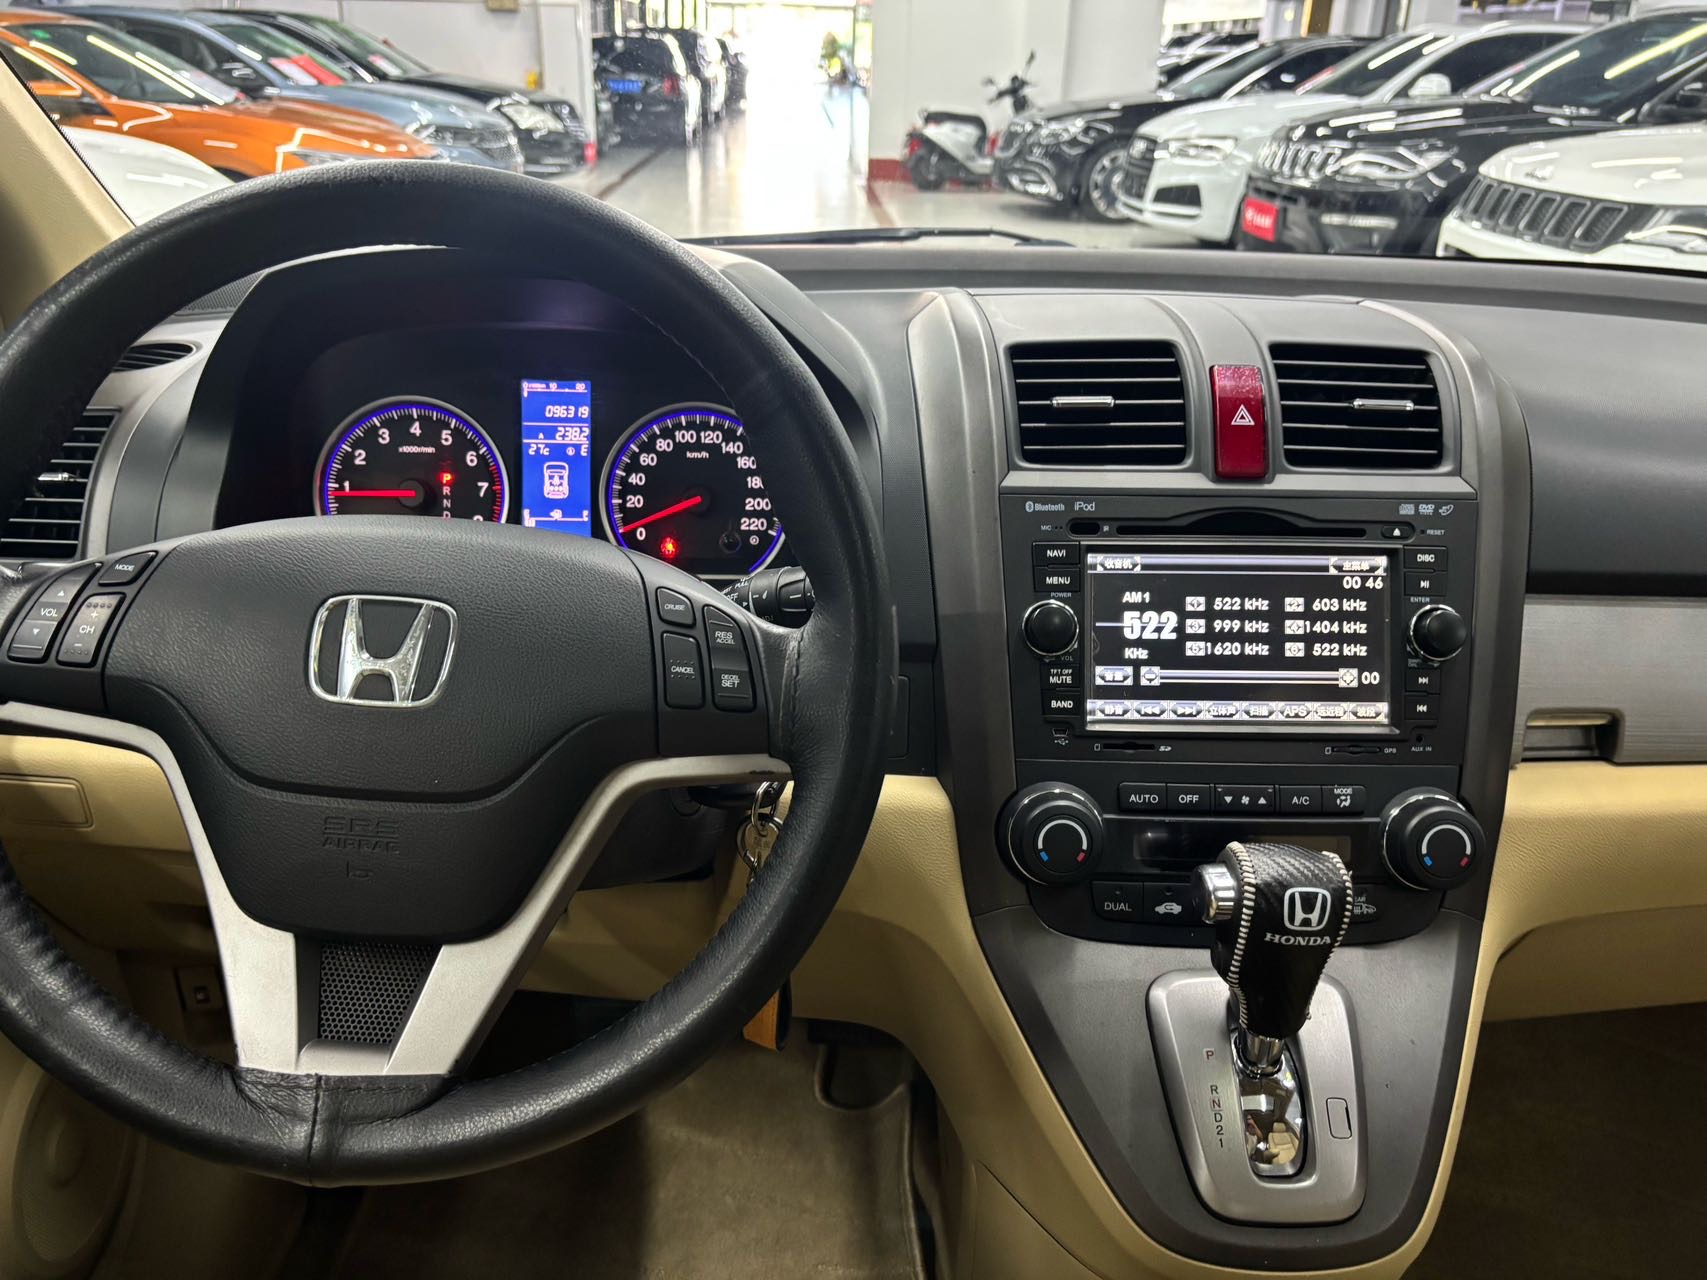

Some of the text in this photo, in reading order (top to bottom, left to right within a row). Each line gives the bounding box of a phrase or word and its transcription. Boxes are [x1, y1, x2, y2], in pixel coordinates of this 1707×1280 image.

[545, 405, 589, 418] 096319
[410, 421, 422, 437] 4
[378, 428, 391, 444] 3
[441, 430, 452, 445] 5
[675, 431, 697, 443] 100
[700, 431, 722, 443] 120
[656, 439, 673, 451] 80
[721, 442, 743, 454] 140
[354, 450, 366, 465] 2
[466, 451, 478, 467] 6
[639, 454, 657, 466] 60
[686, 451, 709, 459] km/h
[737, 456, 757, 469] 160
[442, 473, 452, 484] P
[628, 474, 645, 486] 40
[343, 480, 350, 492] 1
[443, 487, 451, 496] R
[477, 482, 489, 497] 7
[443, 499, 451, 508] N
[626, 495, 643, 507] 20
[745, 498, 771, 511] 200
[1034, 503, 1065, 511] Bluetooth
[1074, 502, 1096, 511] iPod
[740, 518, 767, 531] 220
[636, 528, 646, 540] 0
[1046, 550, 1066, 558] NAVI
[1417, 554, 1435, 562] DISC
[1046, 576, 1071, 585] MENU
[1342, 576, 1384, 589] 00 46
[664, 603, 685, 611] CRUISE
[1213, 597, 1241, 611] 522
[1245, 597, 1269, 611] kHz
[1312, 599, 1339, 612] 603
[1342, 599, 1367, 612] kHz
[40, 608, 58, 617] VOL
[79, 625, 95, 634] CH
[1123, 611, 1178, 640] 522
[1213, 619, 1241, 633] 999
[1245, 619, 1269, 633] kHz
[1305, 621, 1339, 634] 1404
[1342, 621, 1367, 634] kHz
[715, 631, 733, 639] RES
[1124, 647, 1149, 659] KHz
[1206, 642, 1241, 655] 1620
[1245, 642, 1269, 655] kHz
[1312, 643, 1339, 656] 522
[1342, 643, 1367, 656] kHz
[671, 665, 695, 674] CANCEL
[721, 680, 740, 688] SET
[1050, 675, 1072, 684] MUTE
[1361, 671, 1380, 685] 00
[1051, 700, 1073, 709] BAND
[1283, 705, 1308, 716] APS
[1334, 787, 1353, 795] MODE
[1129, 794, 1159, 804] AUTO
[1178, 794, 1199, 804] OFF
[1291, 796, 1310, 805] A/C
[1104, 901, 1132, 911] DUAL
[1264, 932, 1331, 946] HONDA
[1206, 1050, 1214, 1060] P
[1210, 1085, 1219, 1095] R
[1212, 1099, 1221, 1109] N
[1214, 1112, 1223, 1123] D
[1216, 1125, 1224, 1135] 2
[1219, 1138, 1224, 1148] 1
